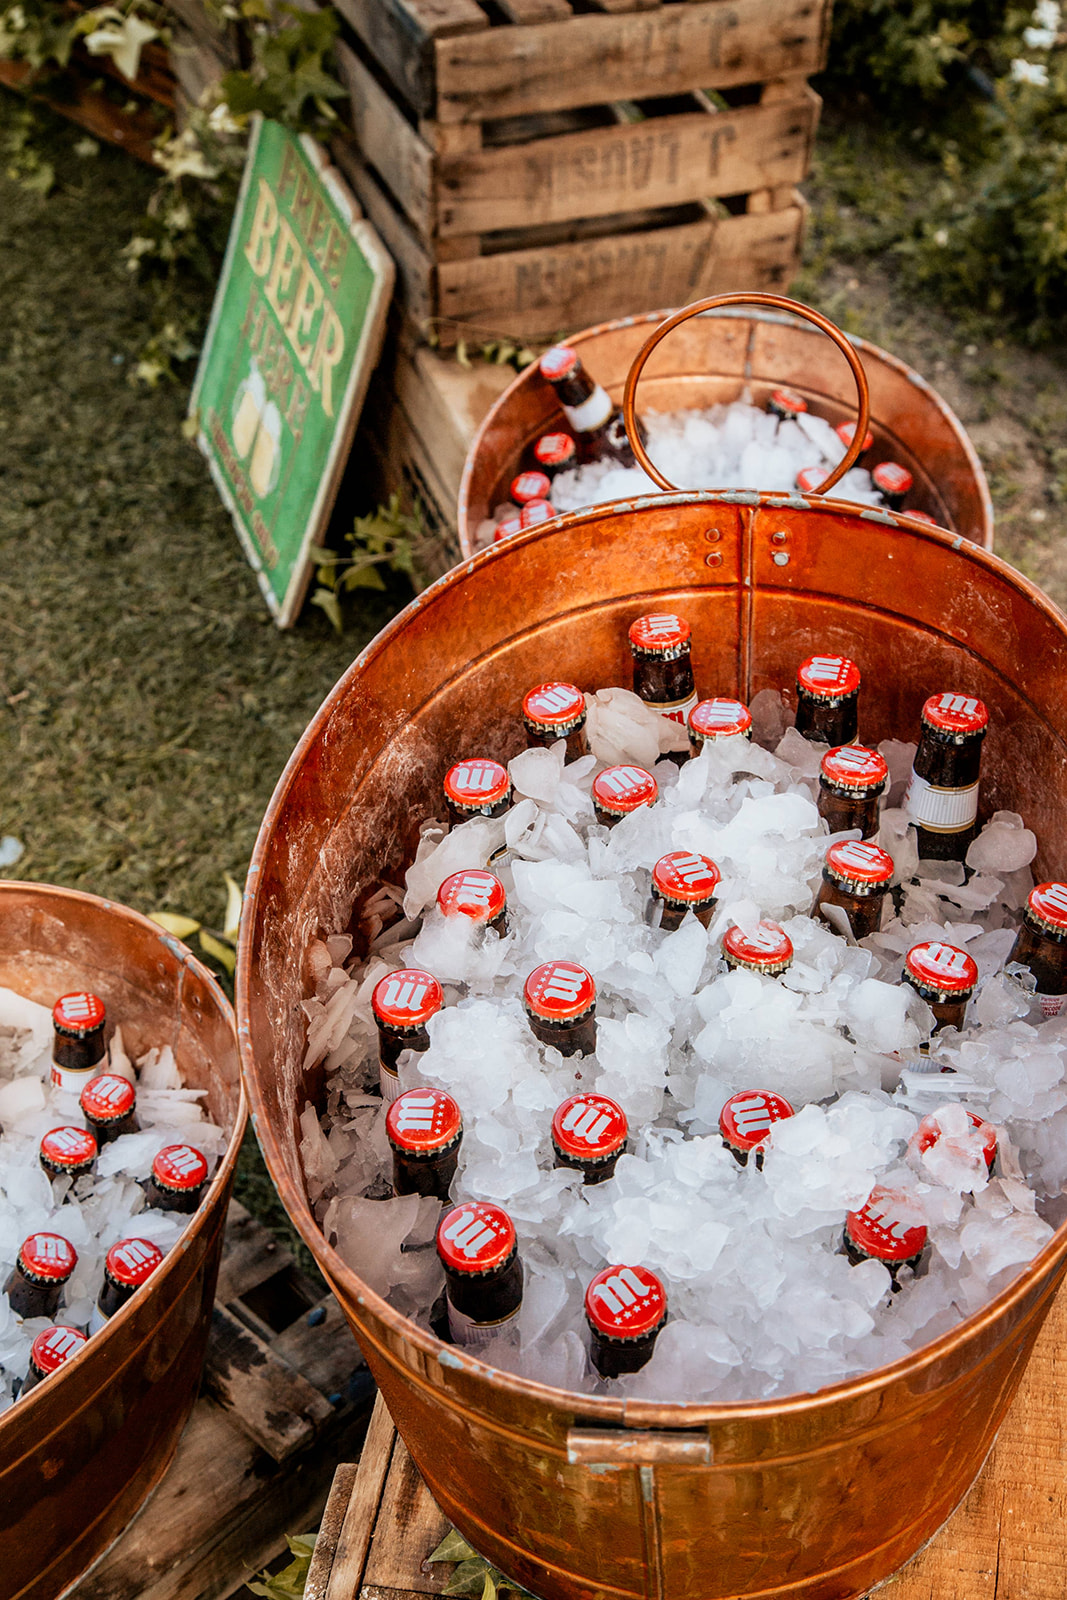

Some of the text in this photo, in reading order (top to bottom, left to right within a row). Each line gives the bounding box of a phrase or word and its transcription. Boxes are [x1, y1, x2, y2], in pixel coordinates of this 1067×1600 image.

[244, 177, 345, 418] BEER
[649, 614, 681, 635] m
[807, 656, 843, 680] m
[536, 686, 579, 714] m
[707, 699, 743, 723] m
[939, 693, 978, 715] m
[830, 747, 871, 769] m
[456, 767, 495, 791] m
[601, 766, 646, 793] m
[836, 841, 881, 867] m
[671, 853, 713, 885] m
[926, 942, 967, 970] m
[383, 979, 427, 1011] m
[544, 967, 586, 1002] m
[61, 994, 90, 1019] m
[92, 1076, 128, 1103] m
[396, 1094, 436, 1133] m
[561, 1102, 612, 1145] m
[730, 1096, 772, 1137] m
[47, 1128, 86, 1151] m
[167, 1146, 202, 1175] m
[34, 1235, 70, 1260] m
[444, 1211, 497, 1258] m
[114, 1239, 154, 1270] m
[593, 1267, 652, 1315] m
